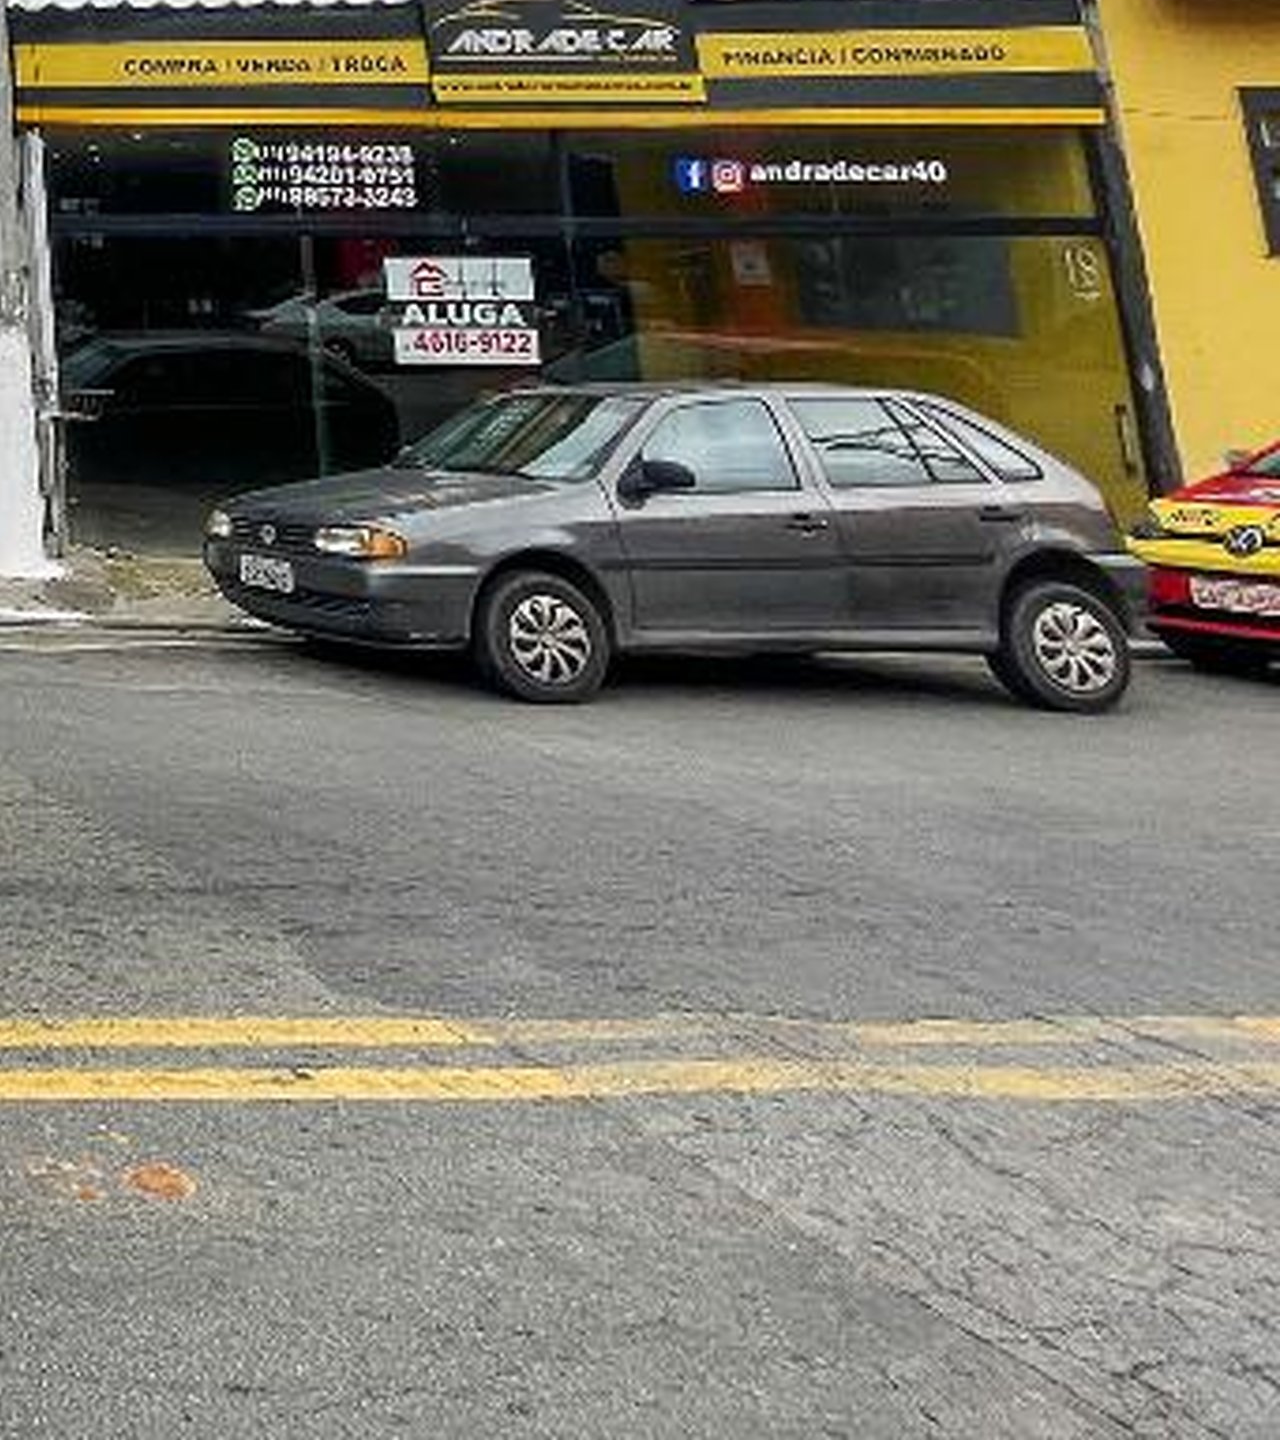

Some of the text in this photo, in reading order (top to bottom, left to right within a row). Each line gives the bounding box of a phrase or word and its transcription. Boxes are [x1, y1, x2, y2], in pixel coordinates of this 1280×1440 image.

[447, 25, 680, 53] ANDRADE CAR
[123, 55, 408, 75] COMPRA VENDA TROCA
[722, 47, 836, 66] FINANCIA
[749, 160, 948, 183] andradecar40
[402, 303, 527, 327] ALUGA
[413, 332, 532, 354] 4616-9122
